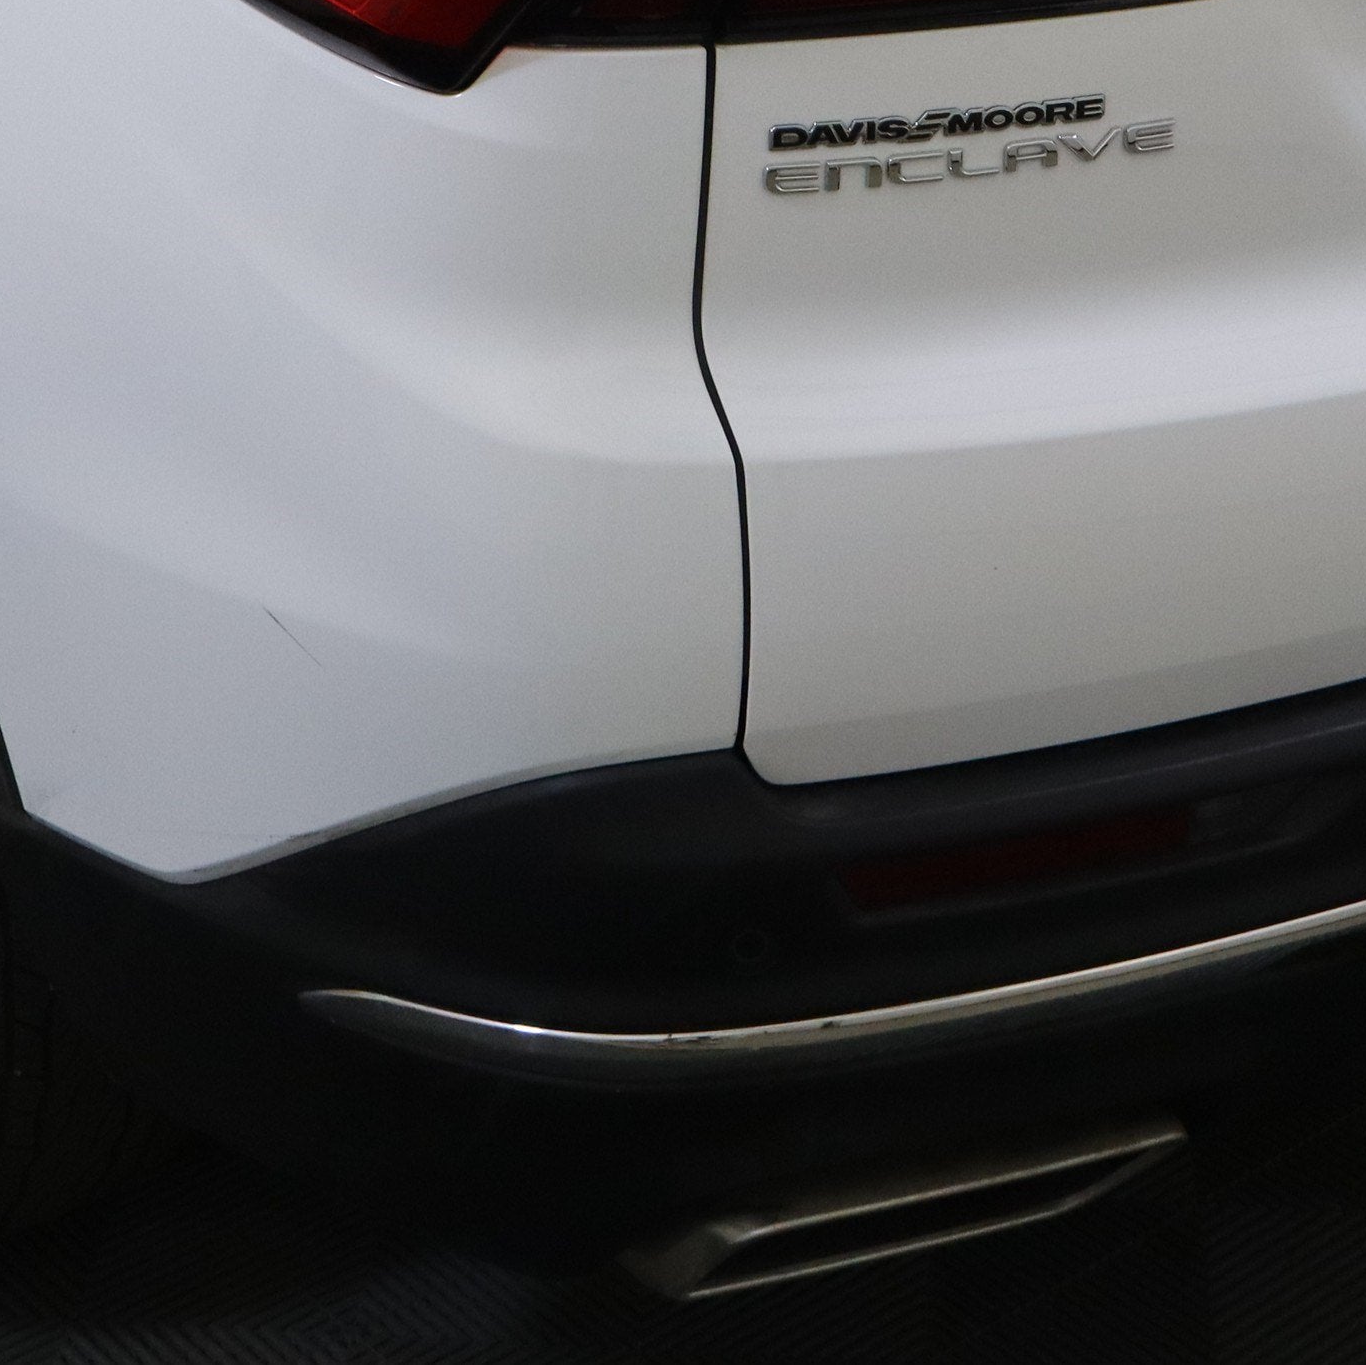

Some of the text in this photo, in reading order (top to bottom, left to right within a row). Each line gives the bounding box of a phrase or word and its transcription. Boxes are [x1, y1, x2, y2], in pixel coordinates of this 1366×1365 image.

[767, 92, 1106, 151] DAVIS MOORE
[763, 117, 1176, 195] ENCLAVE
